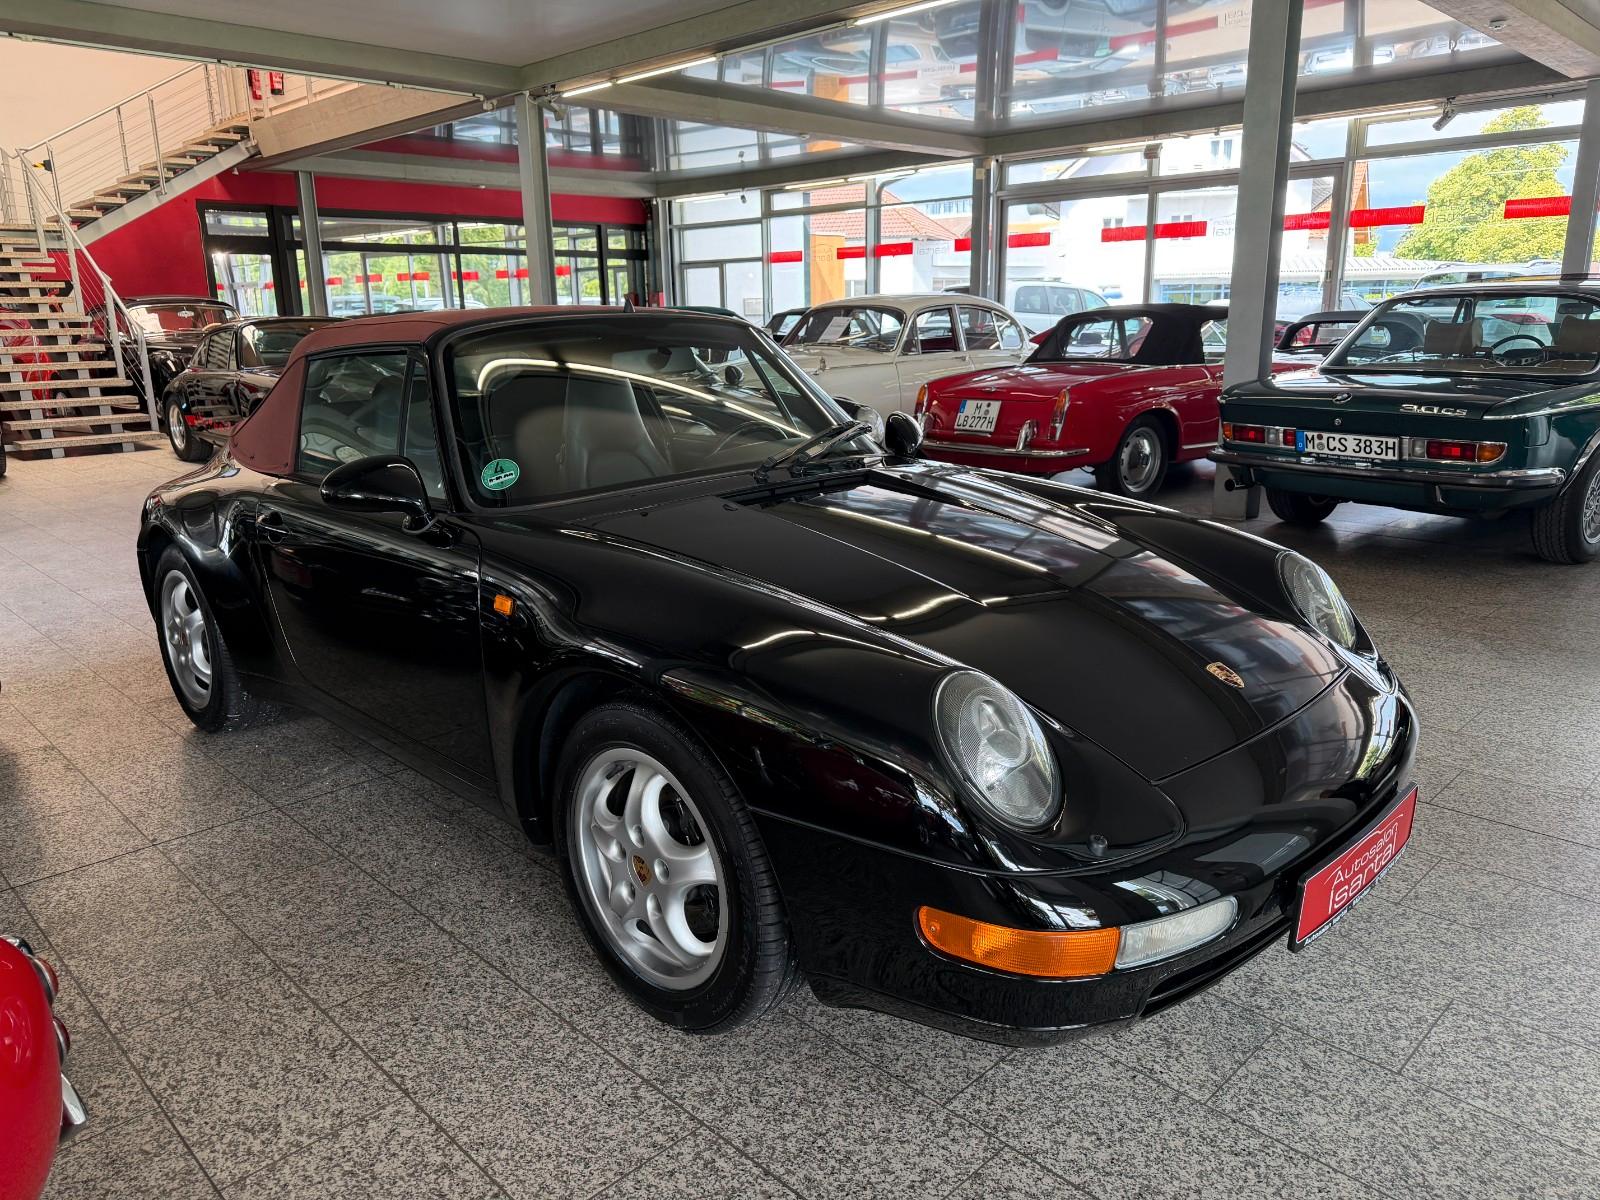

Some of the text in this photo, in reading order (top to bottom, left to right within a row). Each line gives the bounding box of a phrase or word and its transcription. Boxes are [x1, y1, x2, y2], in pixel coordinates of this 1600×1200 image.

[974, 402, 983, 415] M
[1305, 433, 1315, 450] M
[1326, 436, 1348, 453] CS
[1352, 438, 1397, 458] 383H
[494, 461, 504, 473] 4
[1333, 821, 1399, 886] Autosalon
[1328, 832, 1398, 915] Isartal
